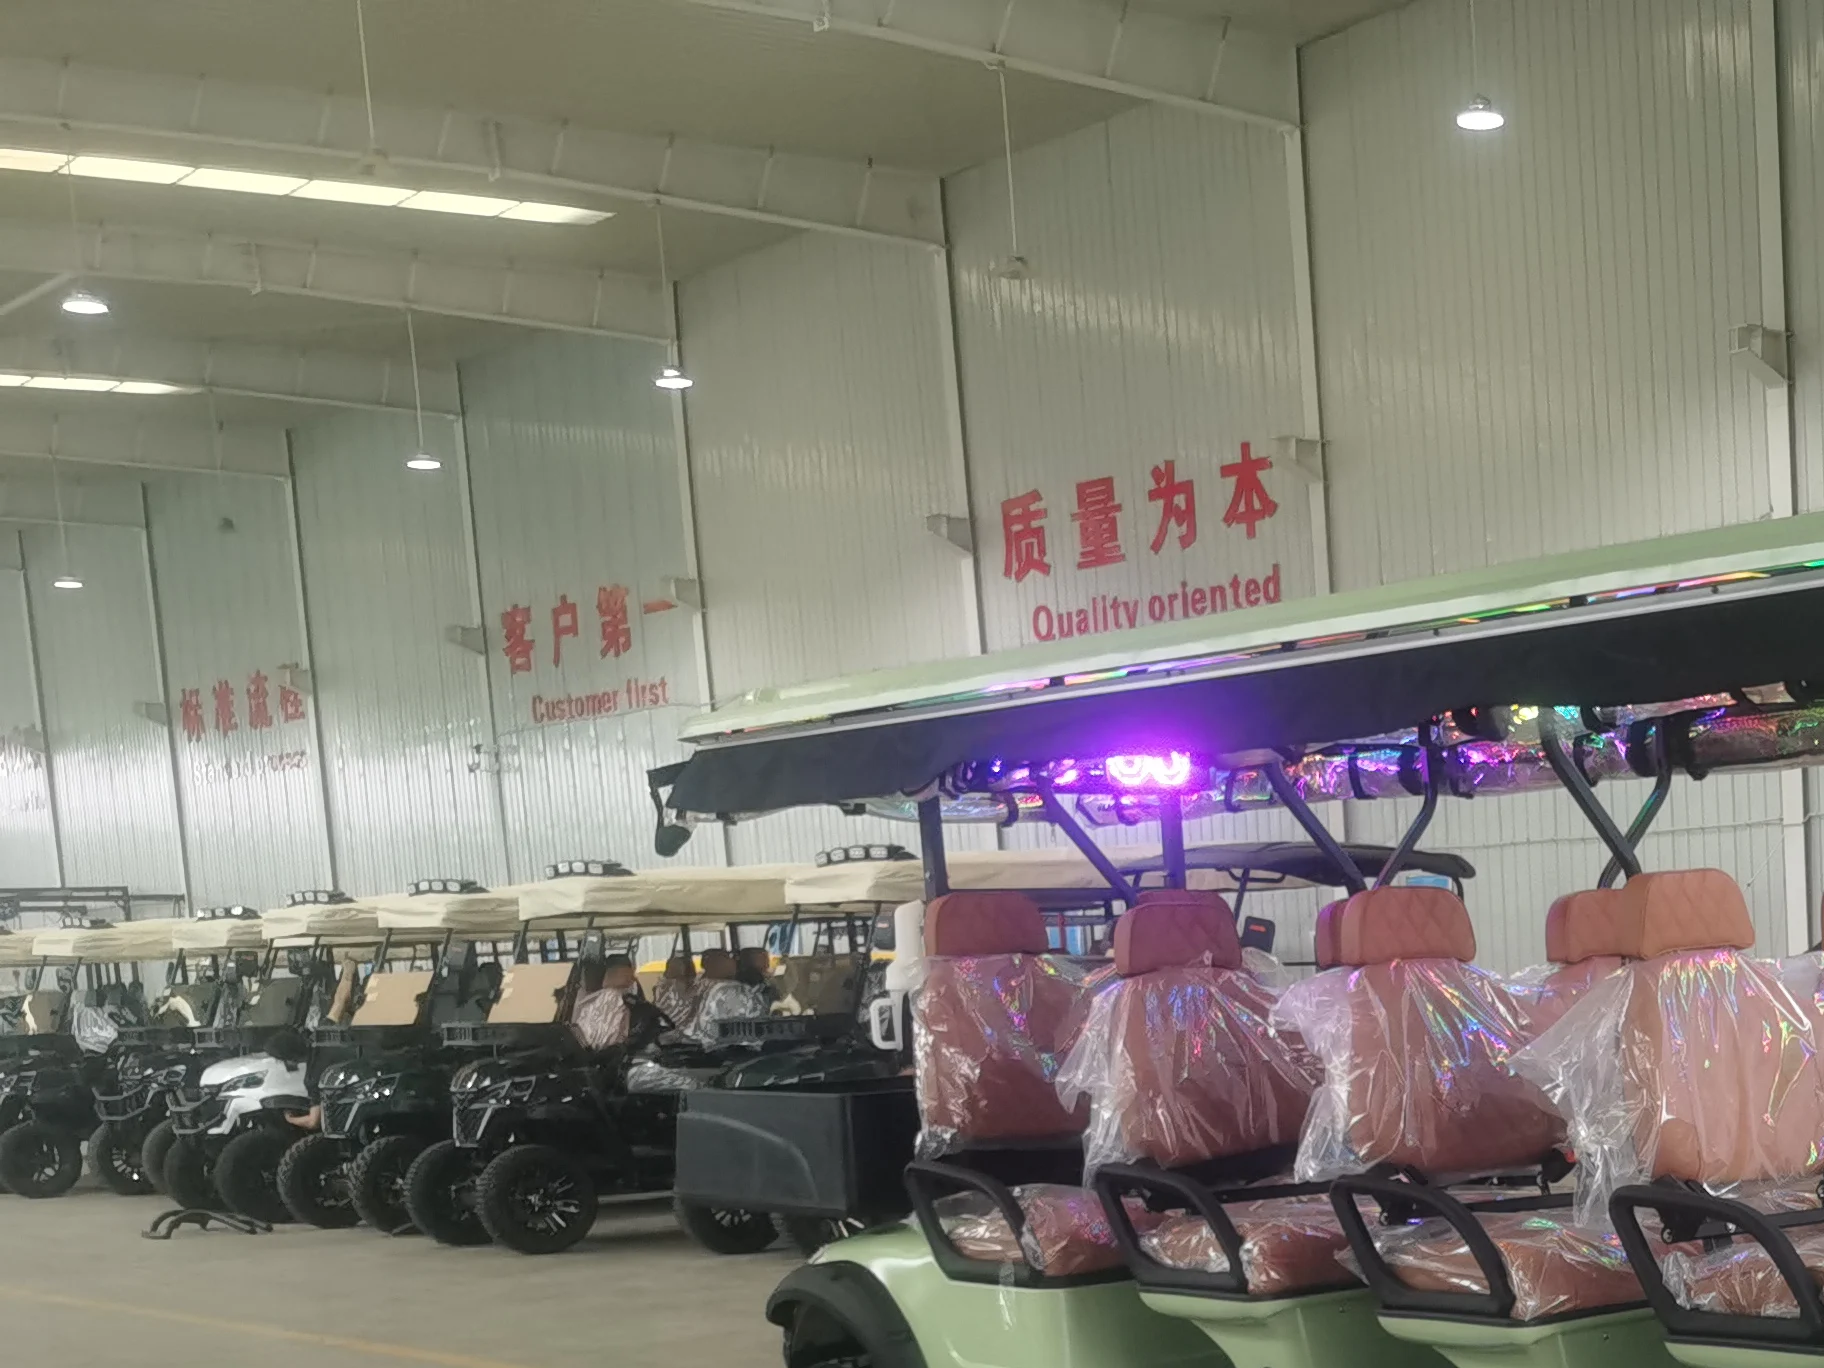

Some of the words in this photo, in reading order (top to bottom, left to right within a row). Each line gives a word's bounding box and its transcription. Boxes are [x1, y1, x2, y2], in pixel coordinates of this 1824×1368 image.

[1000, 441, 1279, 583] 质量为本
[501, 584, 679, 675] 客户第一
[1032, 595, 1139, 642] Quality
[1148, 563, 1282, 622] oriented
[532, 688, 620, 724] Customer
[624, 676, 670, 710] first
